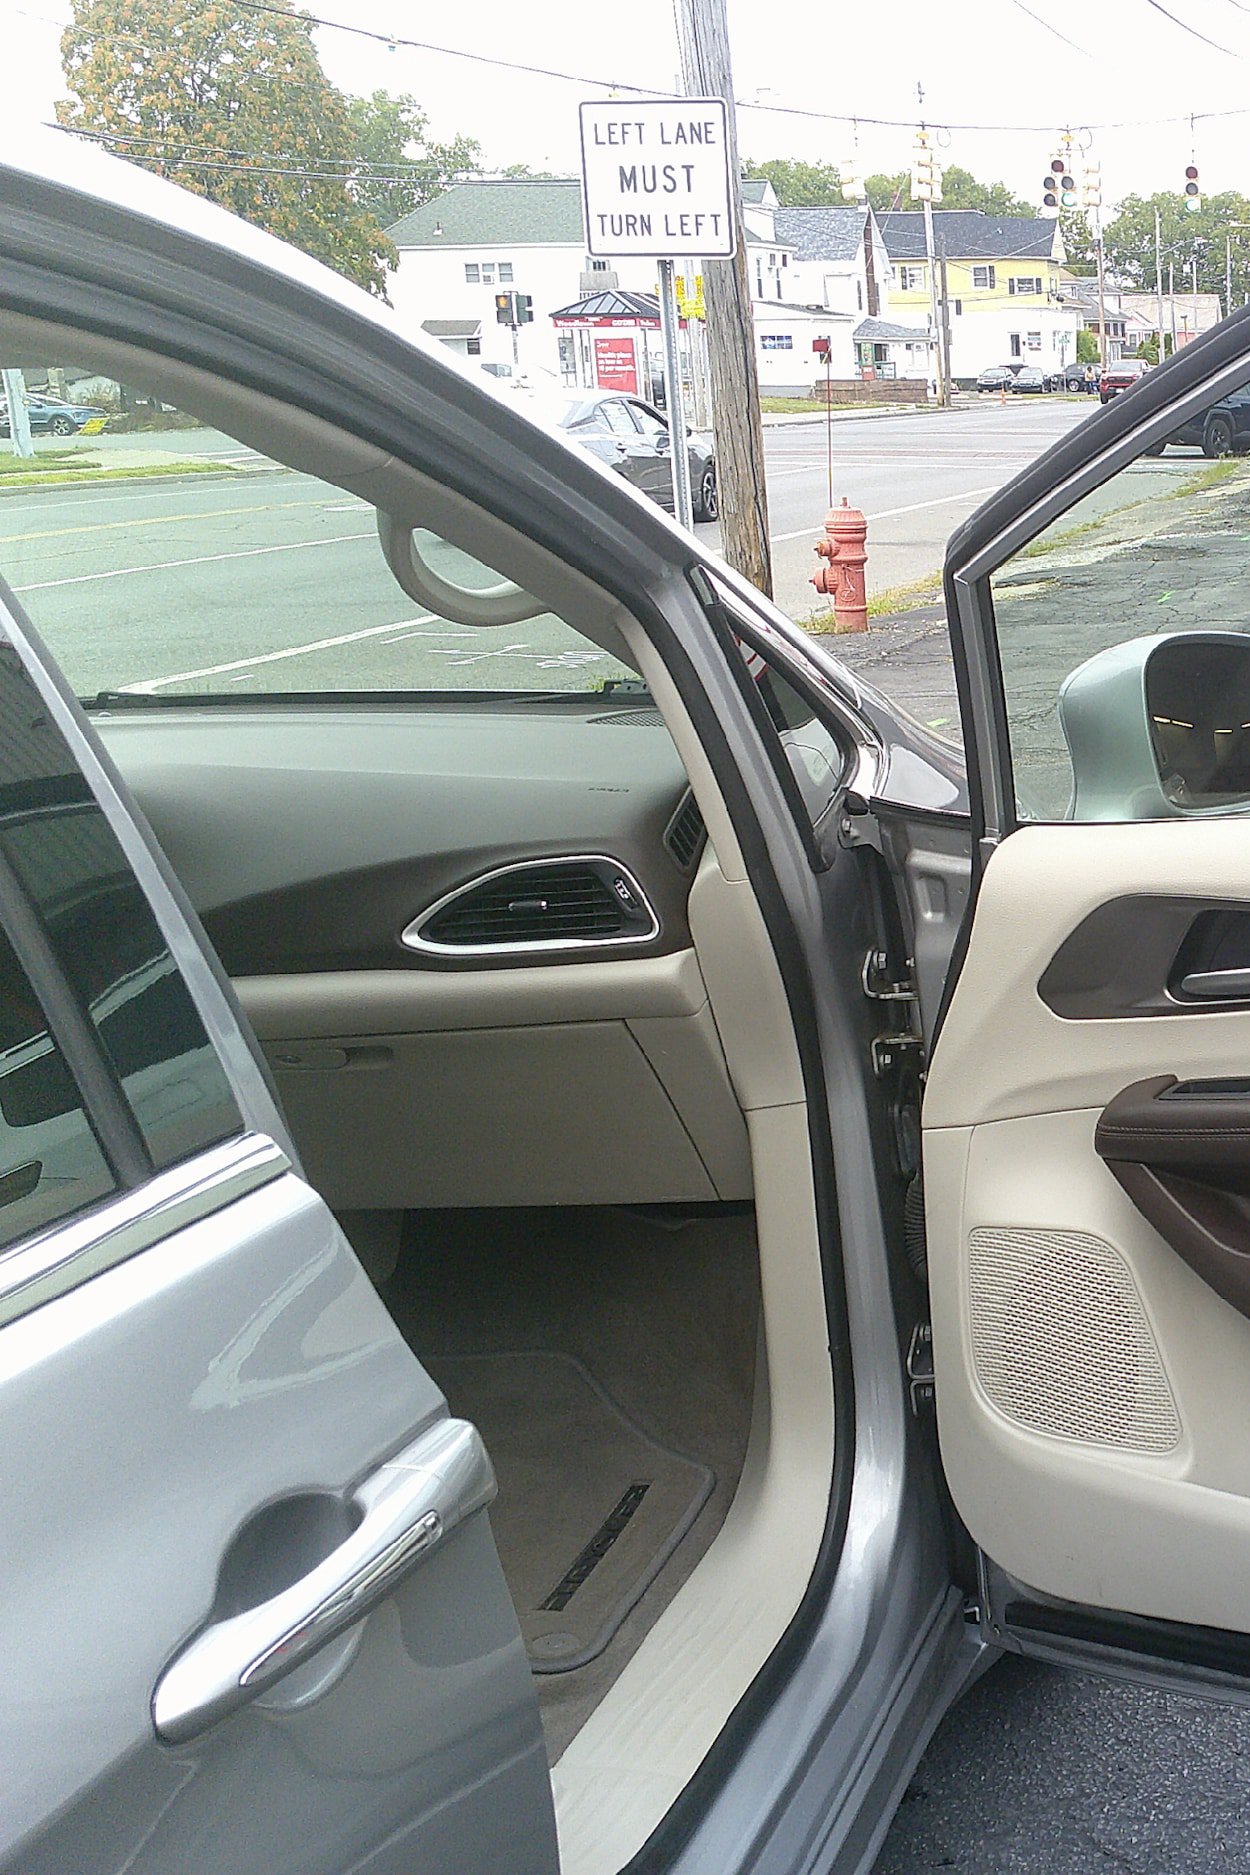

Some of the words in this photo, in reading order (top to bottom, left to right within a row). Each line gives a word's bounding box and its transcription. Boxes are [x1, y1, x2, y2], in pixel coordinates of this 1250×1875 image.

[594, 122, 645, 145] LEFT
[660, 121, 716, 145] LANE
[618, 164, 695, 193] MUST
[597, 213, 652, 237] TURN
[665, 213, 721, 237] LEFT
